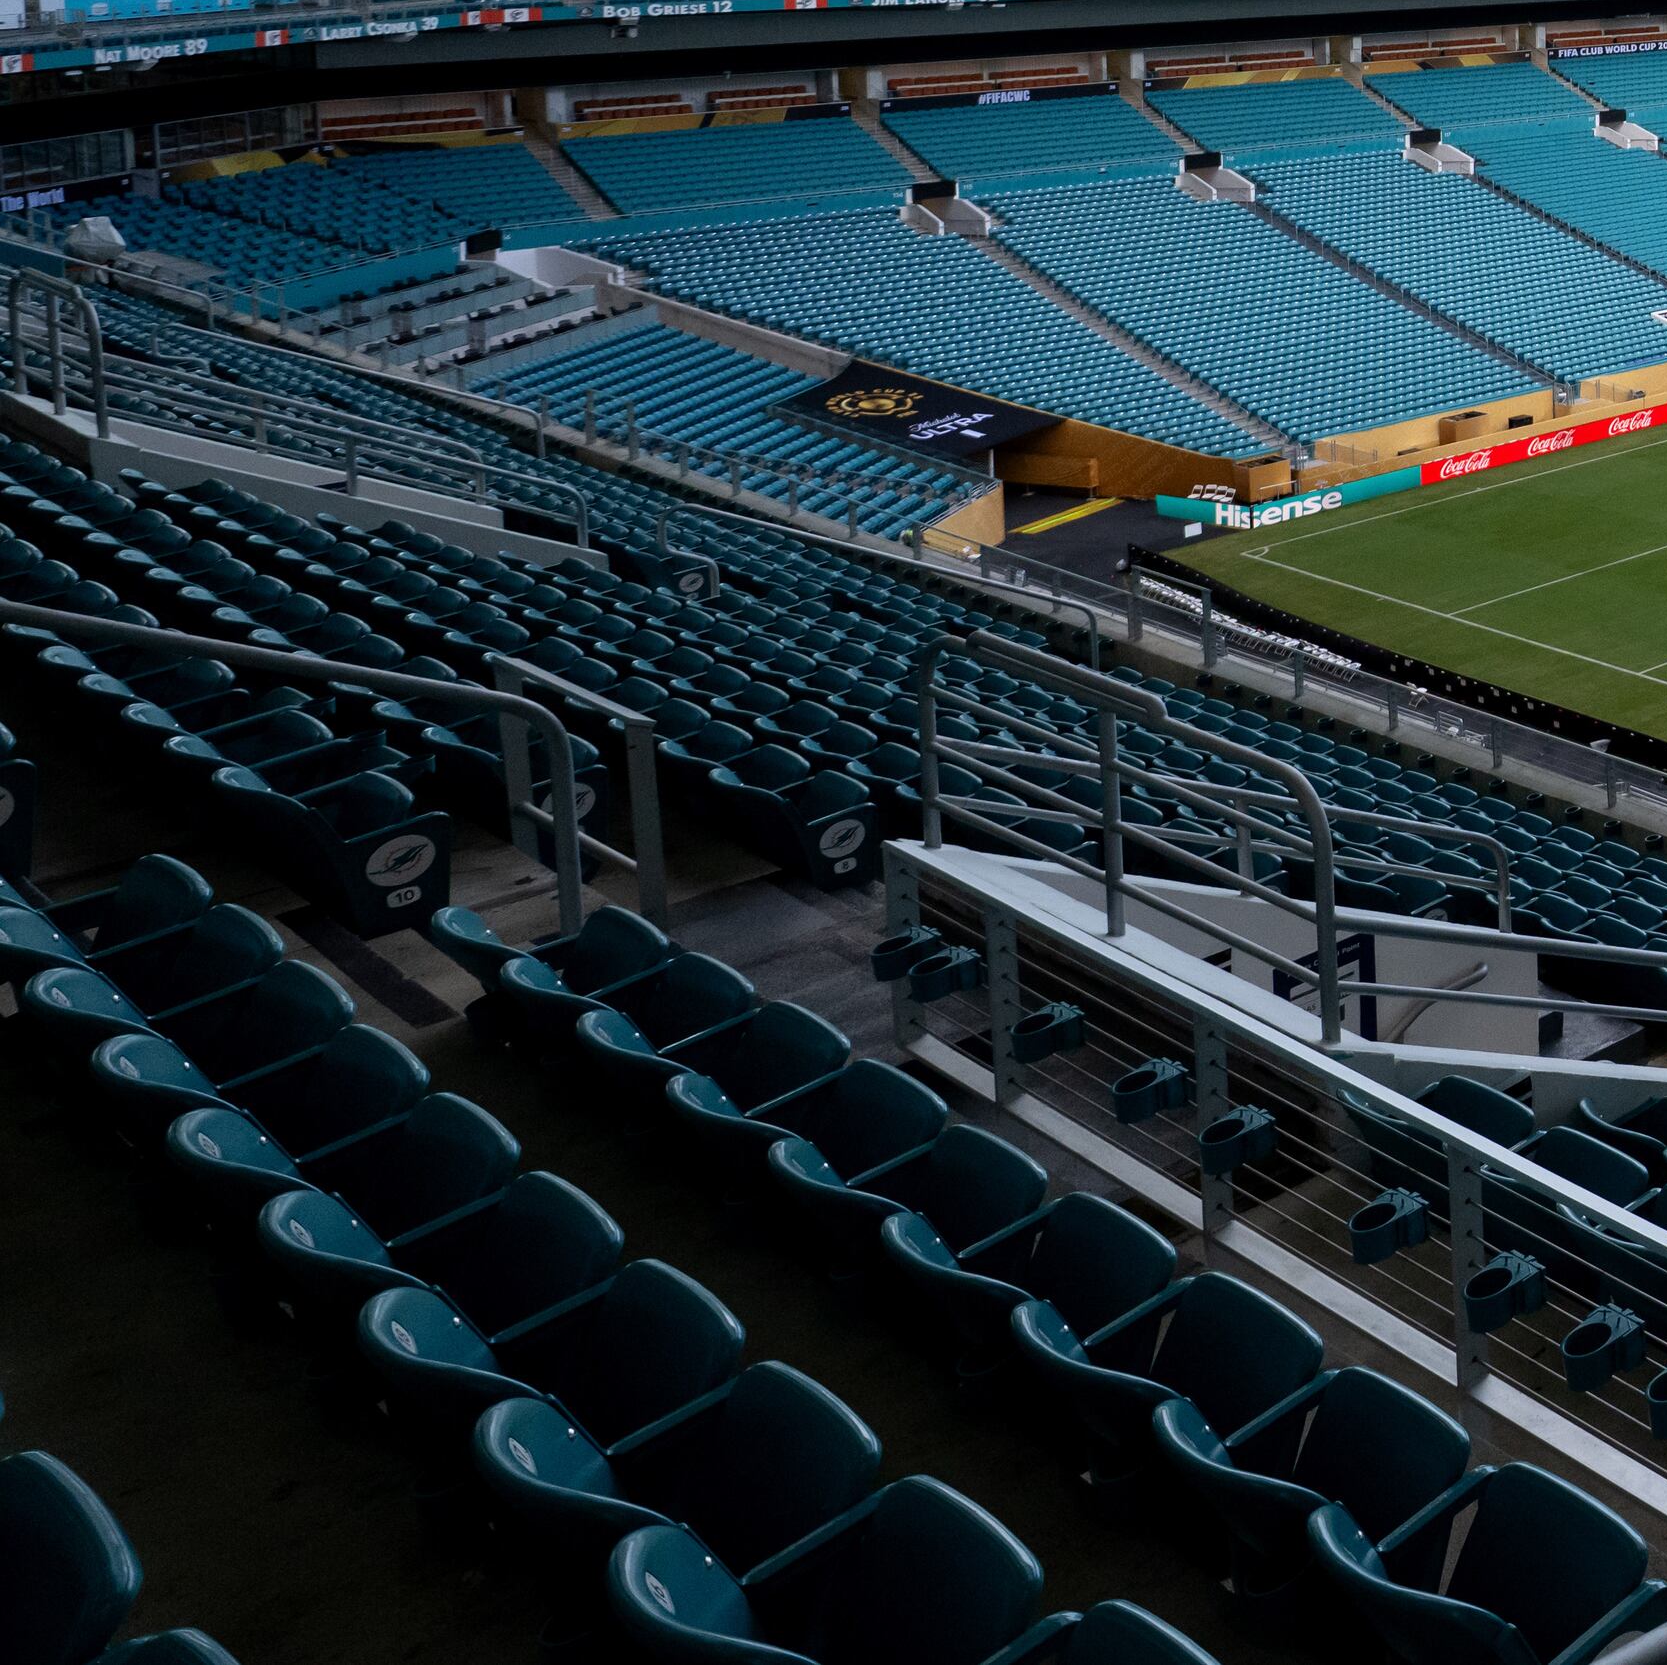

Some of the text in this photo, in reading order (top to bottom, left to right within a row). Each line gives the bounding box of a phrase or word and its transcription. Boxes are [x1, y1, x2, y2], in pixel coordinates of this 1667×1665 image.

[603, 0, 733, 18] BOB GRIESE 12
[321, 16, 440, 41] LARRY CSONKA 39
[94, 38, 208, 64] NAT MOORE 89
[1558, 48, 1579, 58] FIFA
[1580, 46, 1604, 56] CLUB
[1605, 43, 1639, 54] WORLD
[1639, 42, 1657, 52] CUP
[978, 90, 1031, 105] #FIFACWC
[0, 187, 65, 212] The World
[909, 413, 962, 432] Michelob
[909, 413, 994, 440] ULTRA
[1608, 410, 1652, 435] Coca-Cola
[1527, 429, 1575, 456] Coca-Cola
[1440, 450, 1493, 478] Coca-Cola
[1215, 491, 1342, 529] Hisense
[395, 889, 415, 904] 10
[1342, 942, 1360, 955] Point
